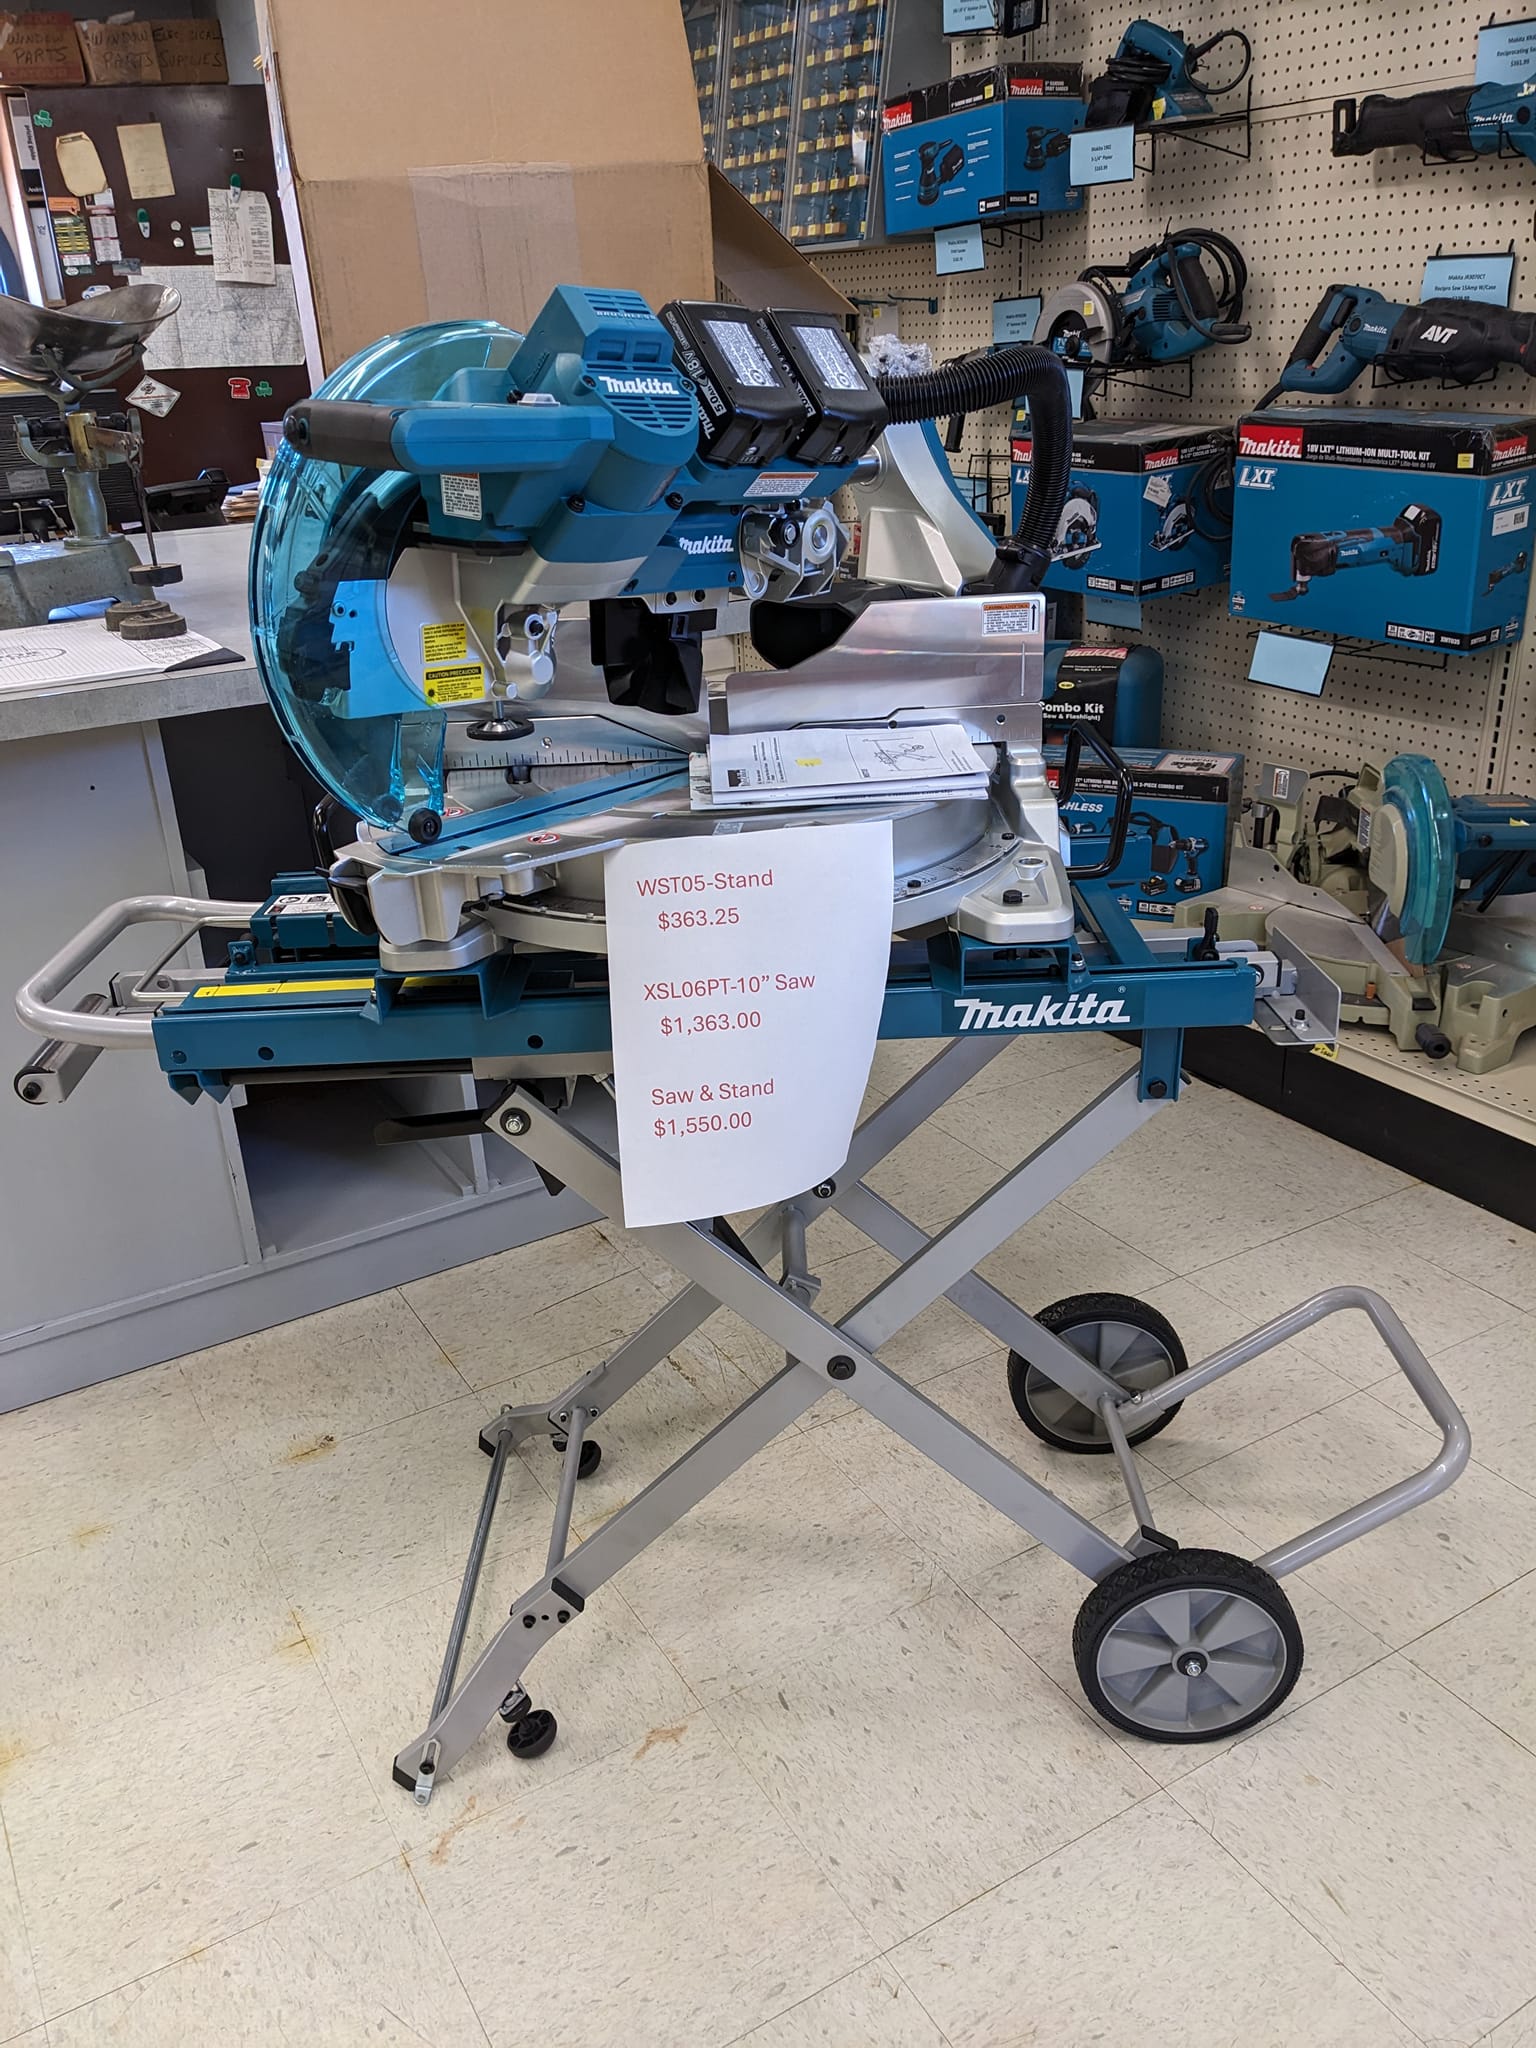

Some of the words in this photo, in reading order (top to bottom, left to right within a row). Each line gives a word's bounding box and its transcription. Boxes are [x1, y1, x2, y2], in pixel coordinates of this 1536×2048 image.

[15, 47, 68, 65] PARTS
[1420, 325, 1458, 344] AVT
[1336, 446, 1377, 457] LITHIUM-ION
[1377, 448, 1417, 461] MULTI-TOOL
[1418, 451, 1432, 461] KIT
[1239, 466, 1275, 489] LXT
[1489, 479, 1527, 507] LXT
[1085, 703, 1104, 714] Kit
[1060, 802, 1104, 813] HLESS
[636, 869, 773, 897] WST05-Stand
[658, 907, 740, 931] $363.25
[775, 973, 816, 991] Saw
[660, 1011, 762, 1036] $1,363.00
[651, 1088, 694, 1106] Saw
[699, 1084, 714, 1102] &
[719, 1078, 774, 1100] Stand
[654, 1111, 752, 1138] $1,550.00
